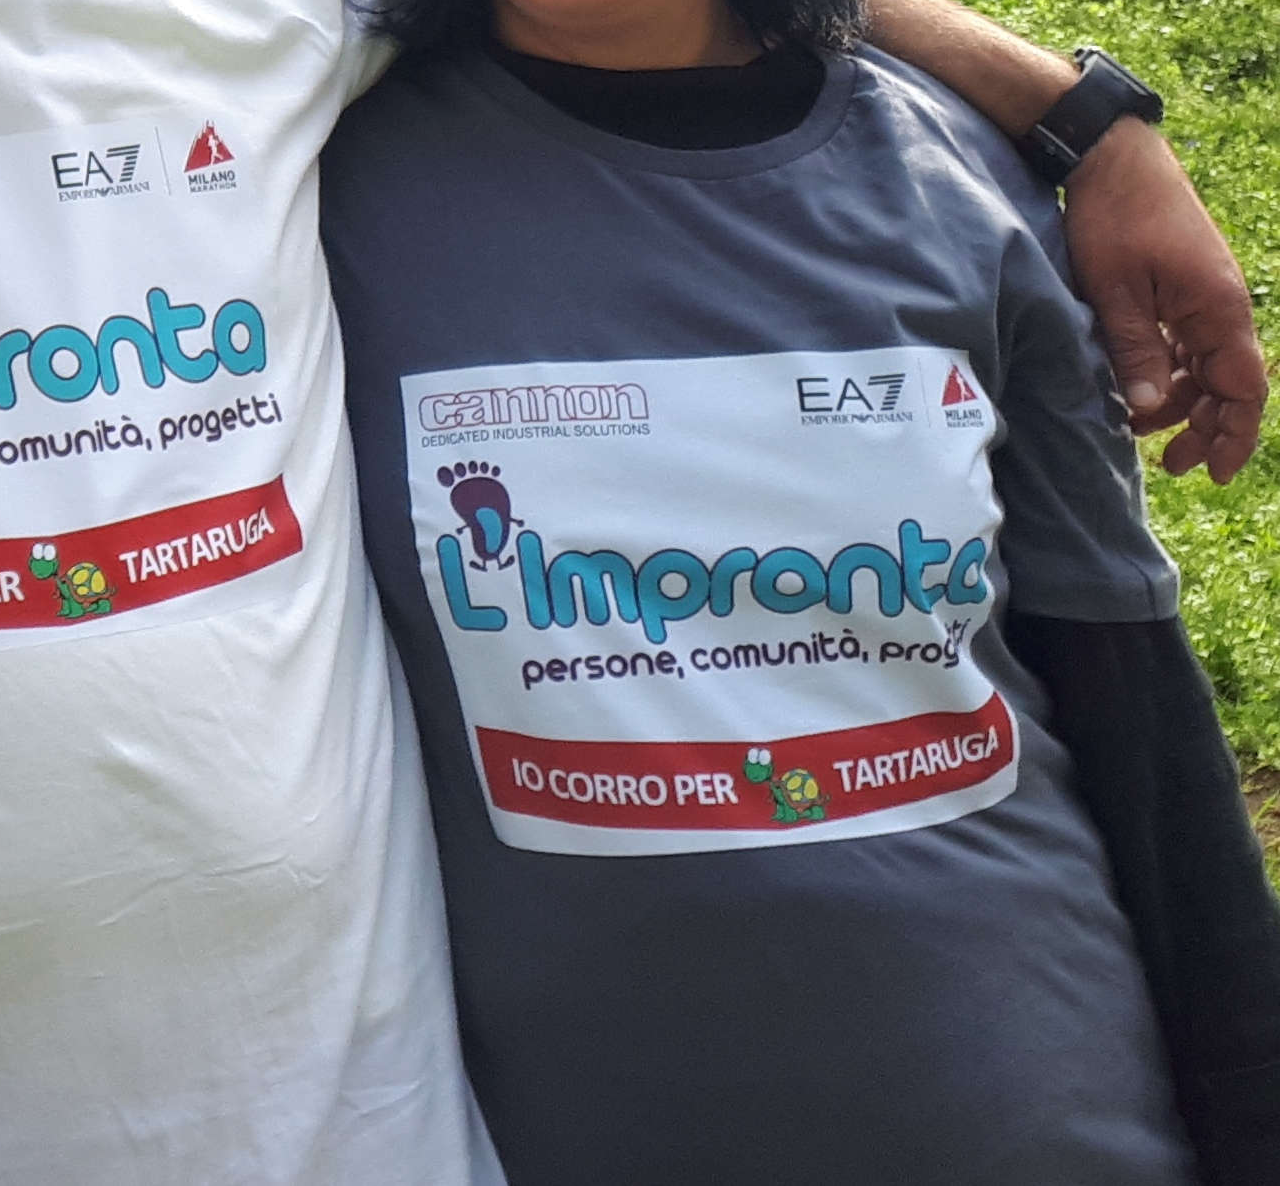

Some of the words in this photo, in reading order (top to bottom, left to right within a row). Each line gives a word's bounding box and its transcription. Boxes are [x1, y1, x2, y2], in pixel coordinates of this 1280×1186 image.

[51, 144, 141, 189] EA7
[188, 170, 236, 186] MILANO
[190, 181, 237, 193] MARATHON
[418, 383, 649, 431] cannon
[797, 373, 905, 413] EA7
[944, 409, 982, 420] MILANO
[159, 393, 282, 450] progetti
[421, 429, 490, 448] DEDICATED
[493, 424, 571, 440] INDUSTRIAL
[574, 423, 651, 437] SOLUTIONS
[119, 507, 275, 583] TARTARUGA
[522, 649, 685, 690] persone,
[690, 629, 870, 672] comunità,
[512, 757, 544, 791] IO
[548, 767, 668, 806] CORRO
[673, 772, 739, 806] PER
[832, 725, 1000, 793] TARTARUGA
